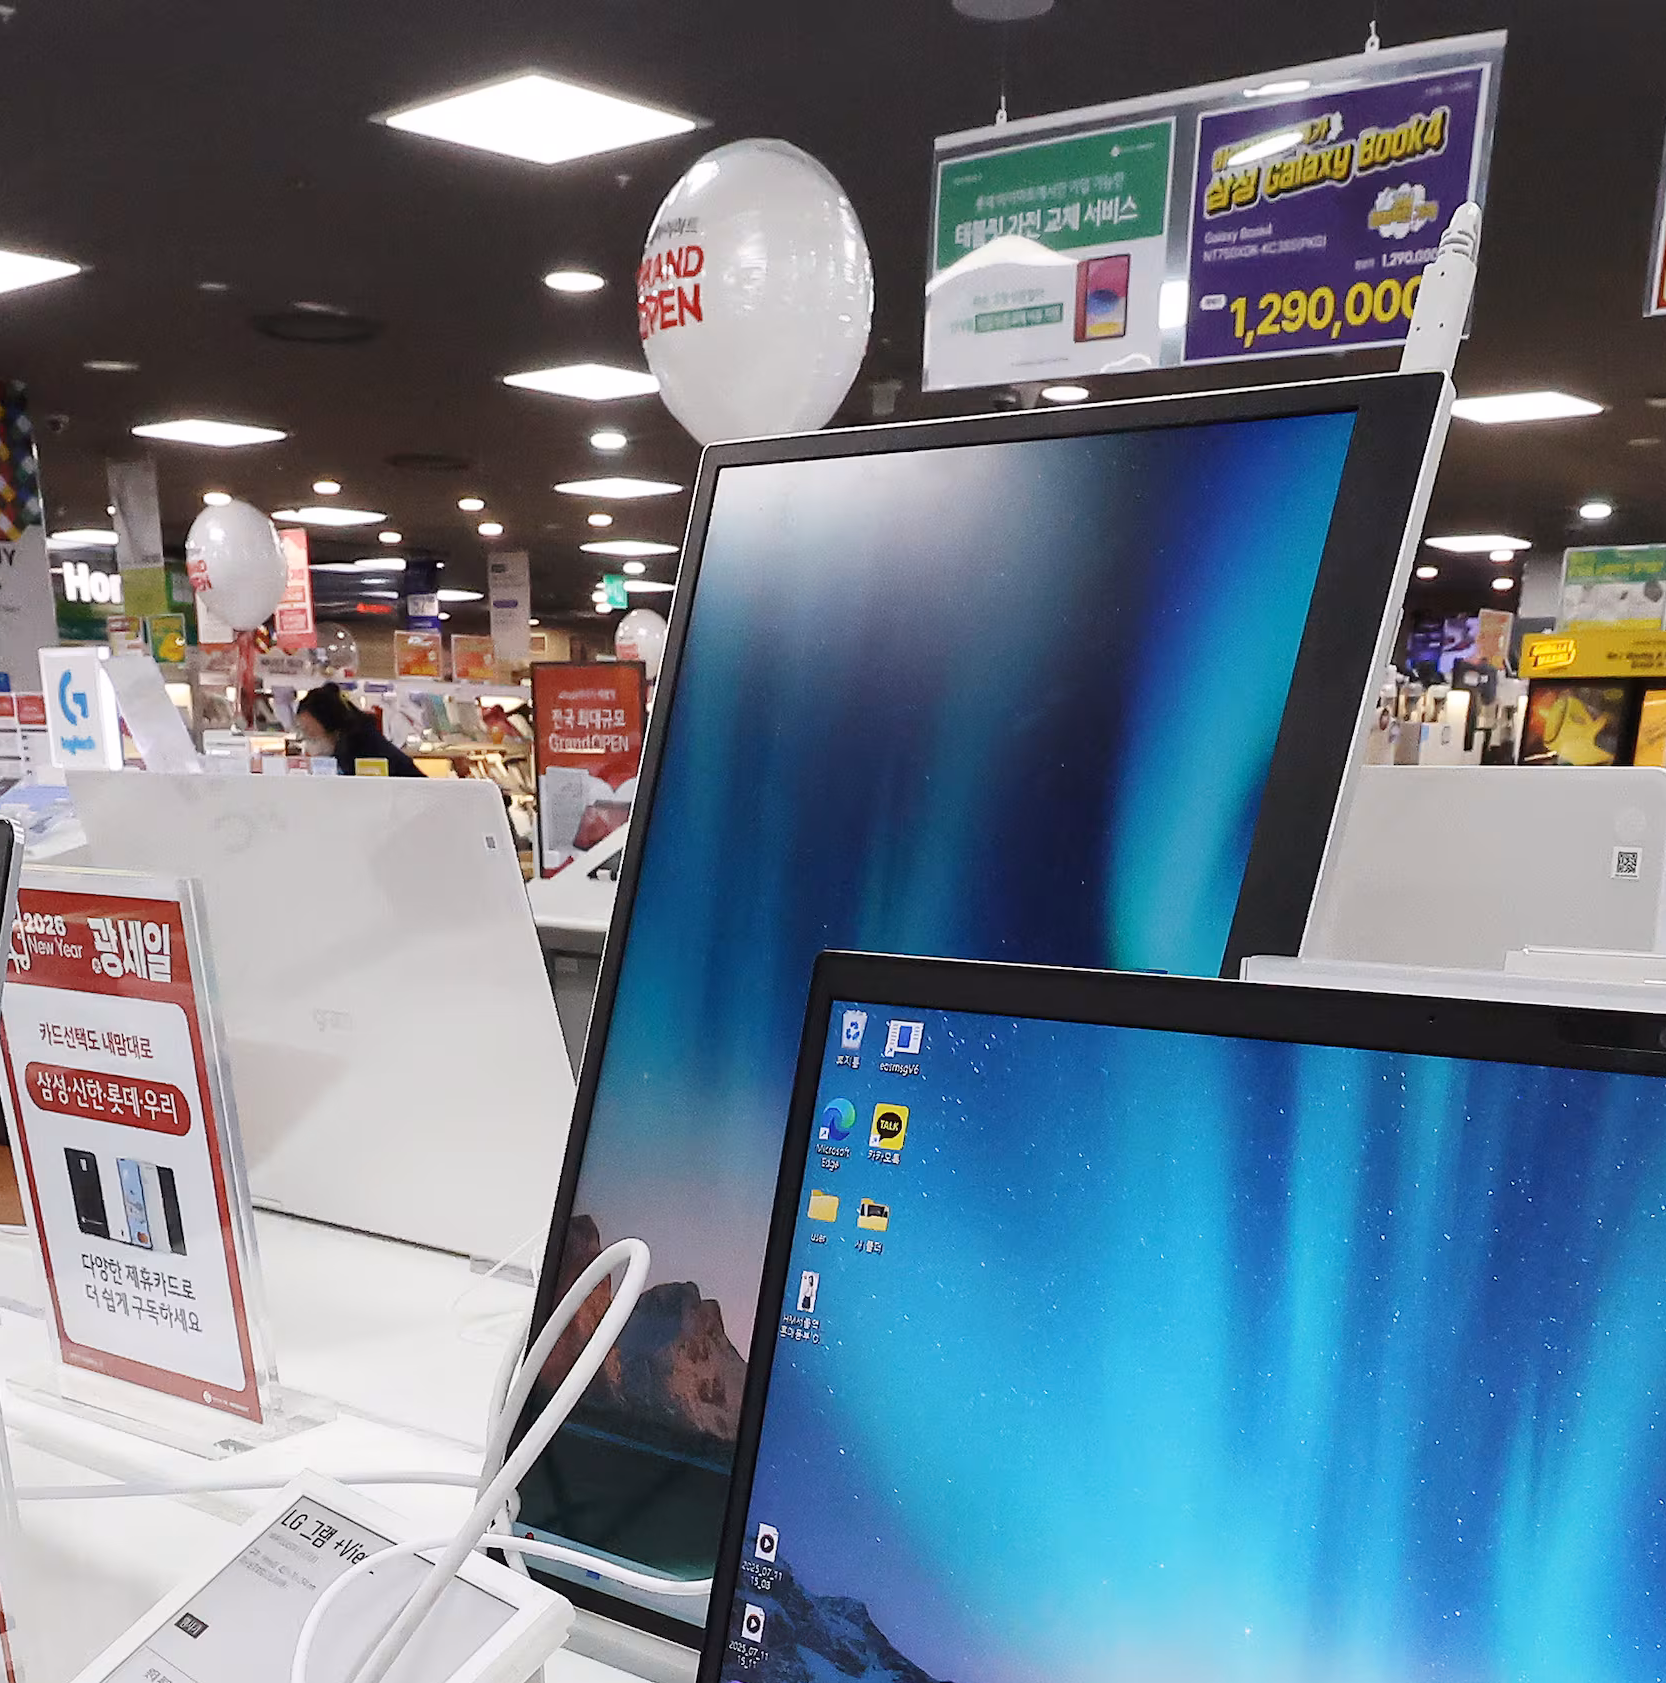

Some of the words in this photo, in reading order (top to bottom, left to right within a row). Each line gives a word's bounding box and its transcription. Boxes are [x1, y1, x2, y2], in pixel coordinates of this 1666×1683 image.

[1206, 166, 1261, 215] 삼성
[1263, 143, 1354, 196] Galaxy
[1085, 195, 1139, 227] 서비스
[23, 912, 67, 937] 2026
[27, 936, 53, 956] New
[55, 938, 83, 960] Year
[87, 917, 172, 983] 광세일
[39, 1022, 101, 1051] 카드선택도
[102, 1031, 153, 1060] 내맘대로
[880, 1119, 900, 1132] TALK
[816, 1143, 852, 1158] Microsoft
[821, 1157, 841, 1171] Edge
[82, 1254, 123, 1286] 다양한
[125, 1264, 196, 1301] 제휴카드로
[86, 1284, 100, 1308] 더
[102, 1288, 130, 1316] 쉽게
[132, 1296, 203, 1333] 구독하세요
[281, 1509, 308, 1530] LG
[300, 1520, 338, 1548] 그램
